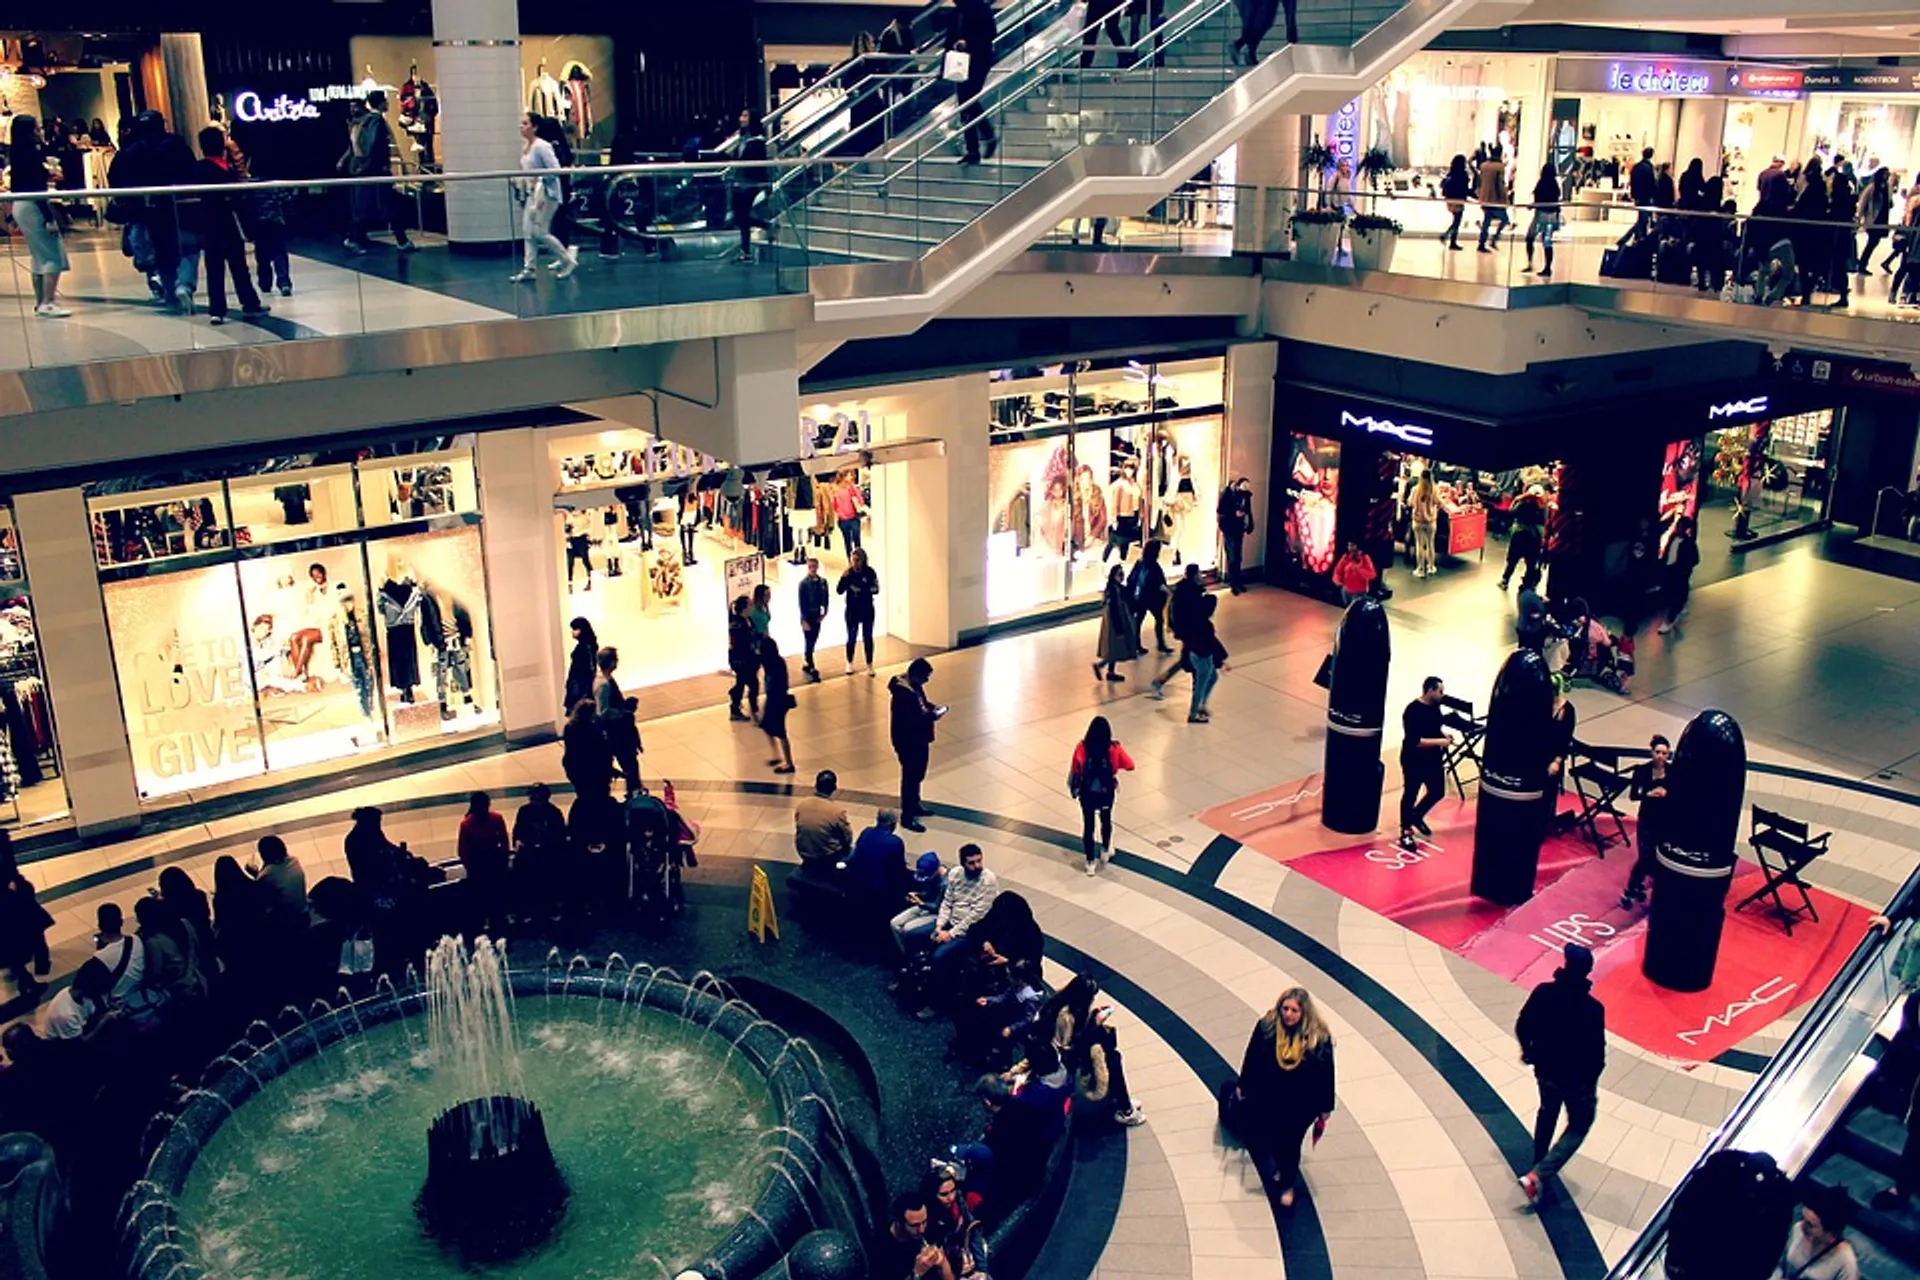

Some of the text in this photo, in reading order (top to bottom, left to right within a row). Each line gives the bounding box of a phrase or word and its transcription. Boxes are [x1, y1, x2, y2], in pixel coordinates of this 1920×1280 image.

[580, 195, 589, 212] 2
[624, 198, 635, 216] 2
[1708, 396, 1768, 419] MAC
[1341, 410, 1433, 445] MAC
[141, 663, 244, 716] LOVE
[150, 728, 255, 779] GIVE
